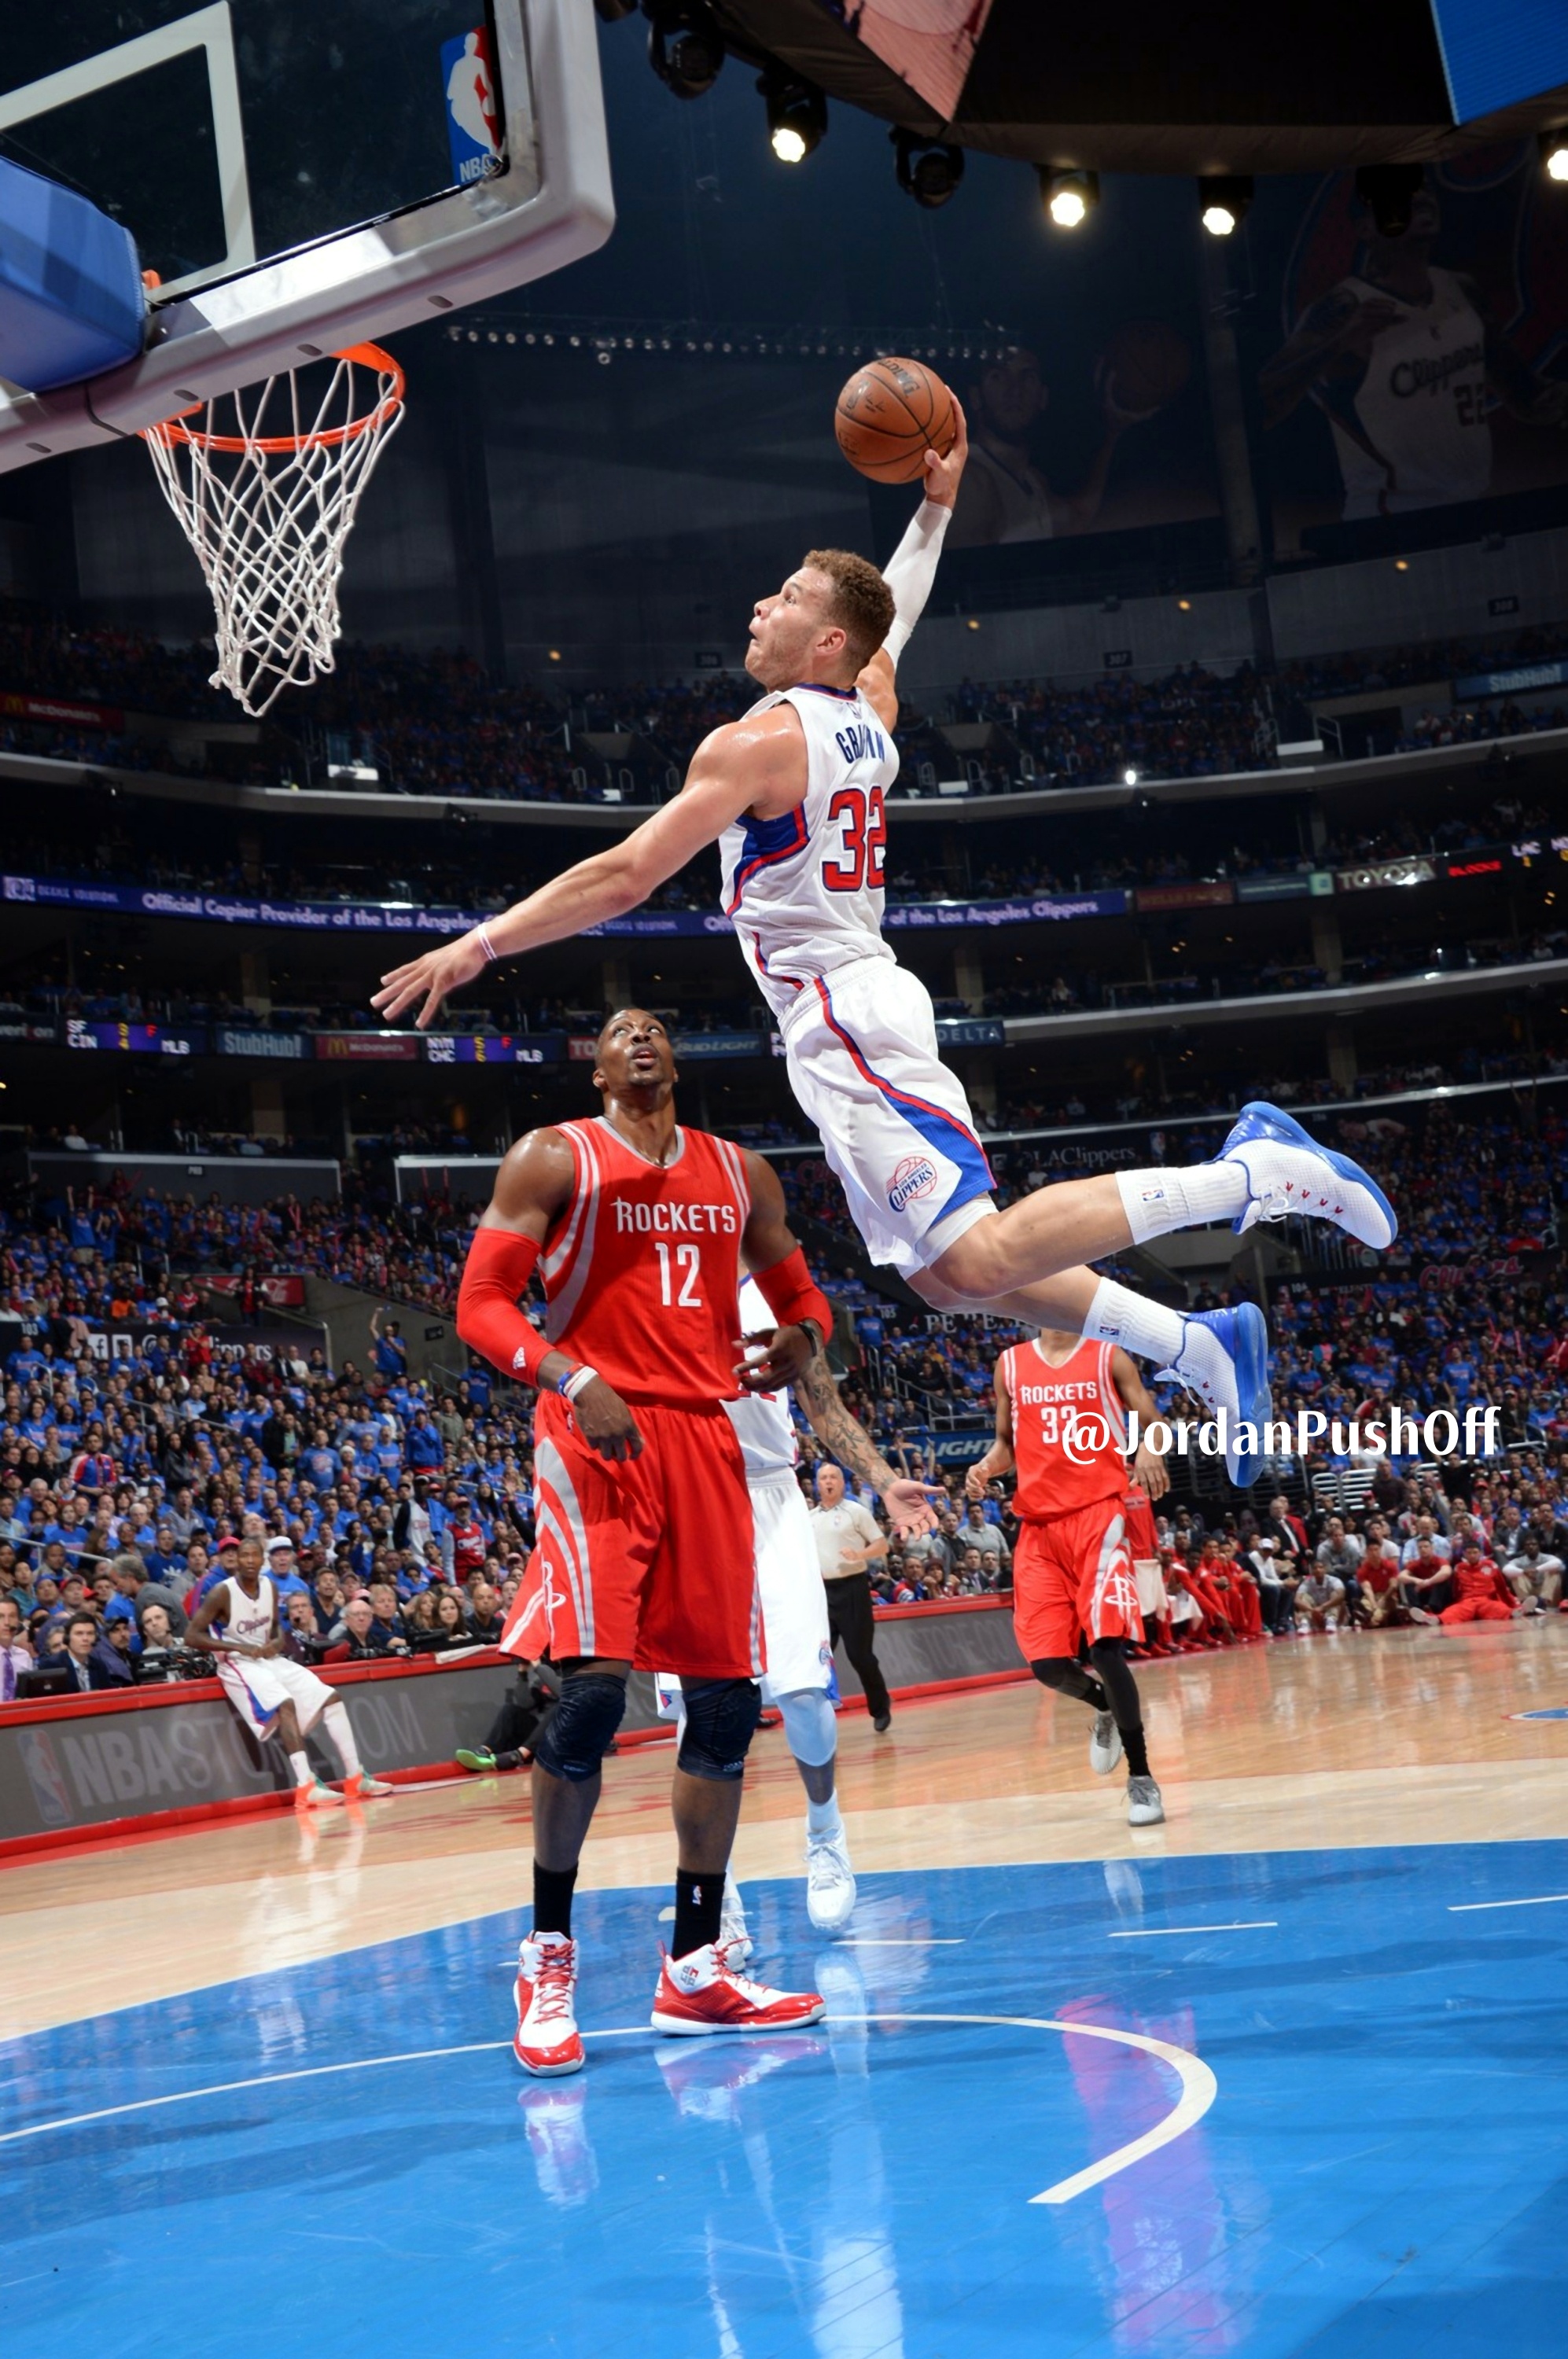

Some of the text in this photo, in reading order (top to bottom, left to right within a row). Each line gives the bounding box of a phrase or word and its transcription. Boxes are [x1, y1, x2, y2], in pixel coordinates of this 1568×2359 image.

[822, 786, 886, 892] 32
[1338, 861, 1437, 889] TOYOTA
[142, 892, 202, 914] Official
[204, 899, 258, 922] Copier
[260, 903, 329, 926] Provider
[333, 907, 352, 926] of
[355, 909, 382, 926] the
[385, 909, 413, 928] Los
[420, 912, 480, 934] Angeles
[889, 909, 907, 925] of
[909, 908, 935, 924] the
[937, 908, 964, 924] Los
[966, 903, 1030, 926] Angeles
[1032, 900, 1099, 920] Clippers
[161, 1040, 190, 1054] MLB
[224, 1032, 302, 1058] StubHub!
[937, 1027, 1002, 1042] DELTA
[889, 1167, 933, 1213] CLIPPERS
[609, 1196, 736, 1234] ROCKETS
[654, 1242, 702, 1307] 12
[1019, 1381, 1098, 1405] ROCKETS
